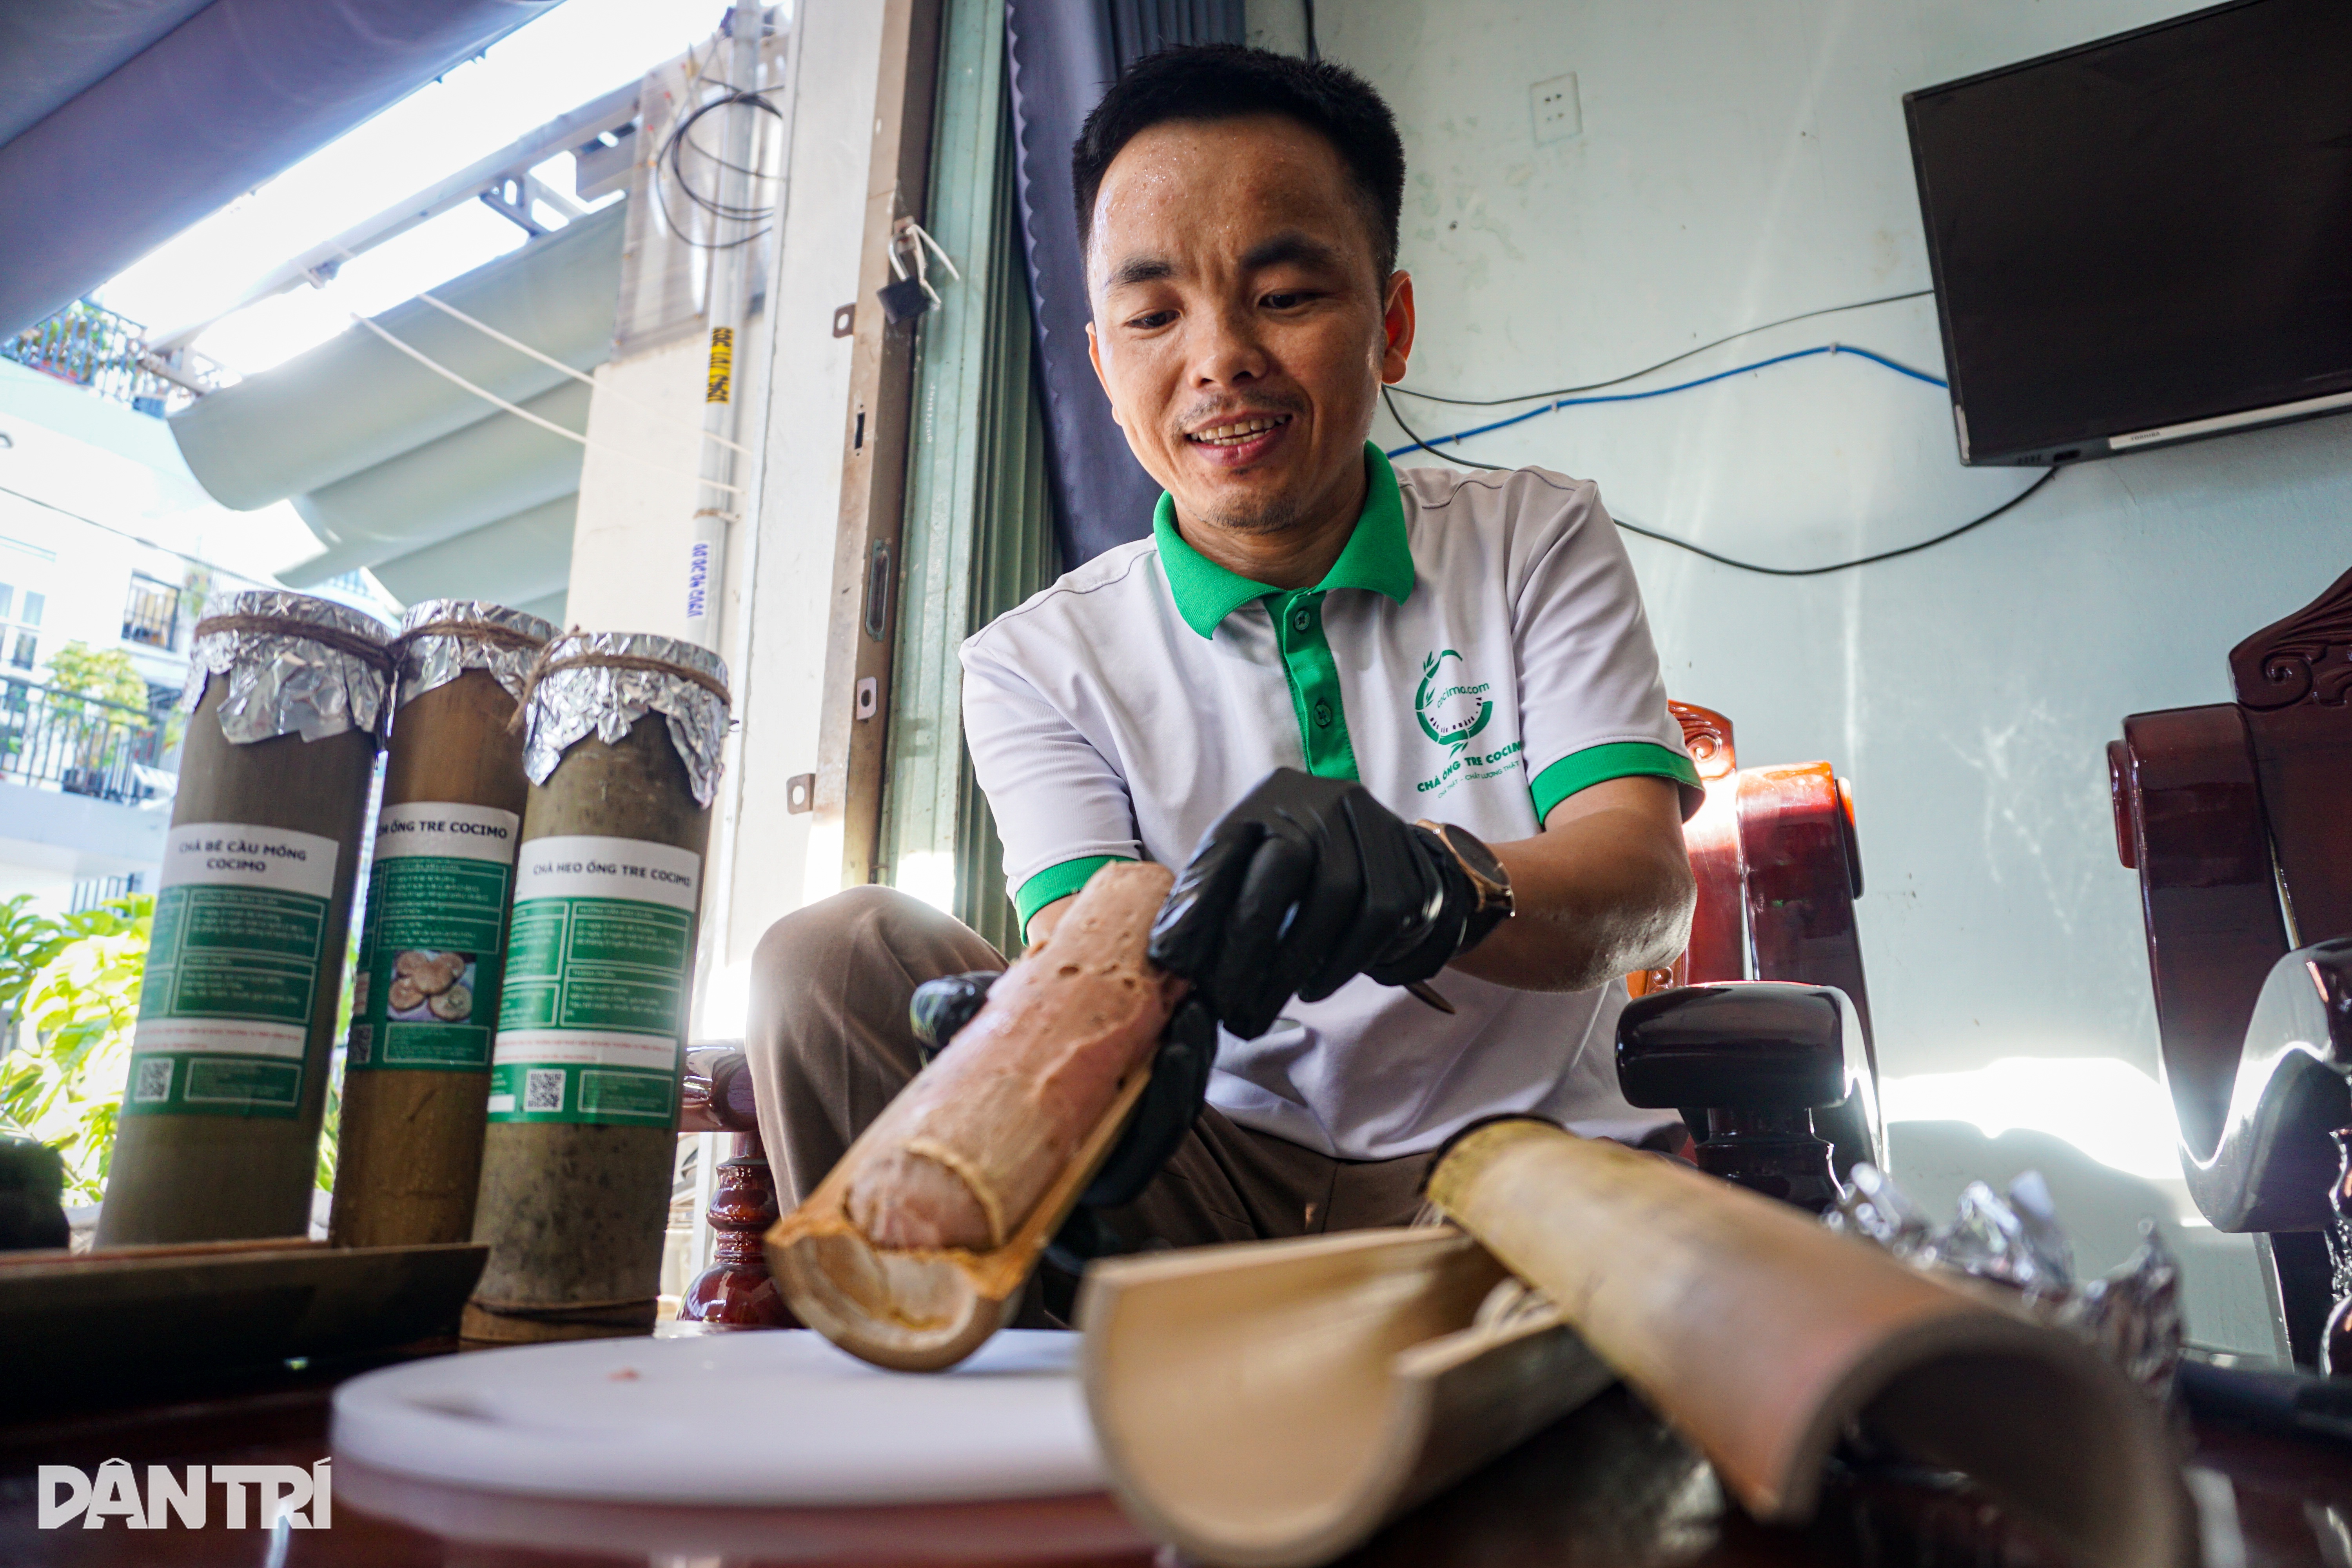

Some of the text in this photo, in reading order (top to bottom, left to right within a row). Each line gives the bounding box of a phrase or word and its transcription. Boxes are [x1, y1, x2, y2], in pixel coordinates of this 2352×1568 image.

[2131, 432, 2160, 440] TOSHIBA
[1417, 775, 1441, 792] CHẢ
[1464, 756, 1483, 766] TRE
[419, 821, 445, 832] TRE
[449, 822, 508, 839] COCIMO
[207, 858, 266, 872] COCIMO
[534, 862, 552, 875] CHẢ
[556, 862, 583, 873] HEO
[621, 864, 646, 878] TRE
[650, 868, 691, 887] COCIMO
